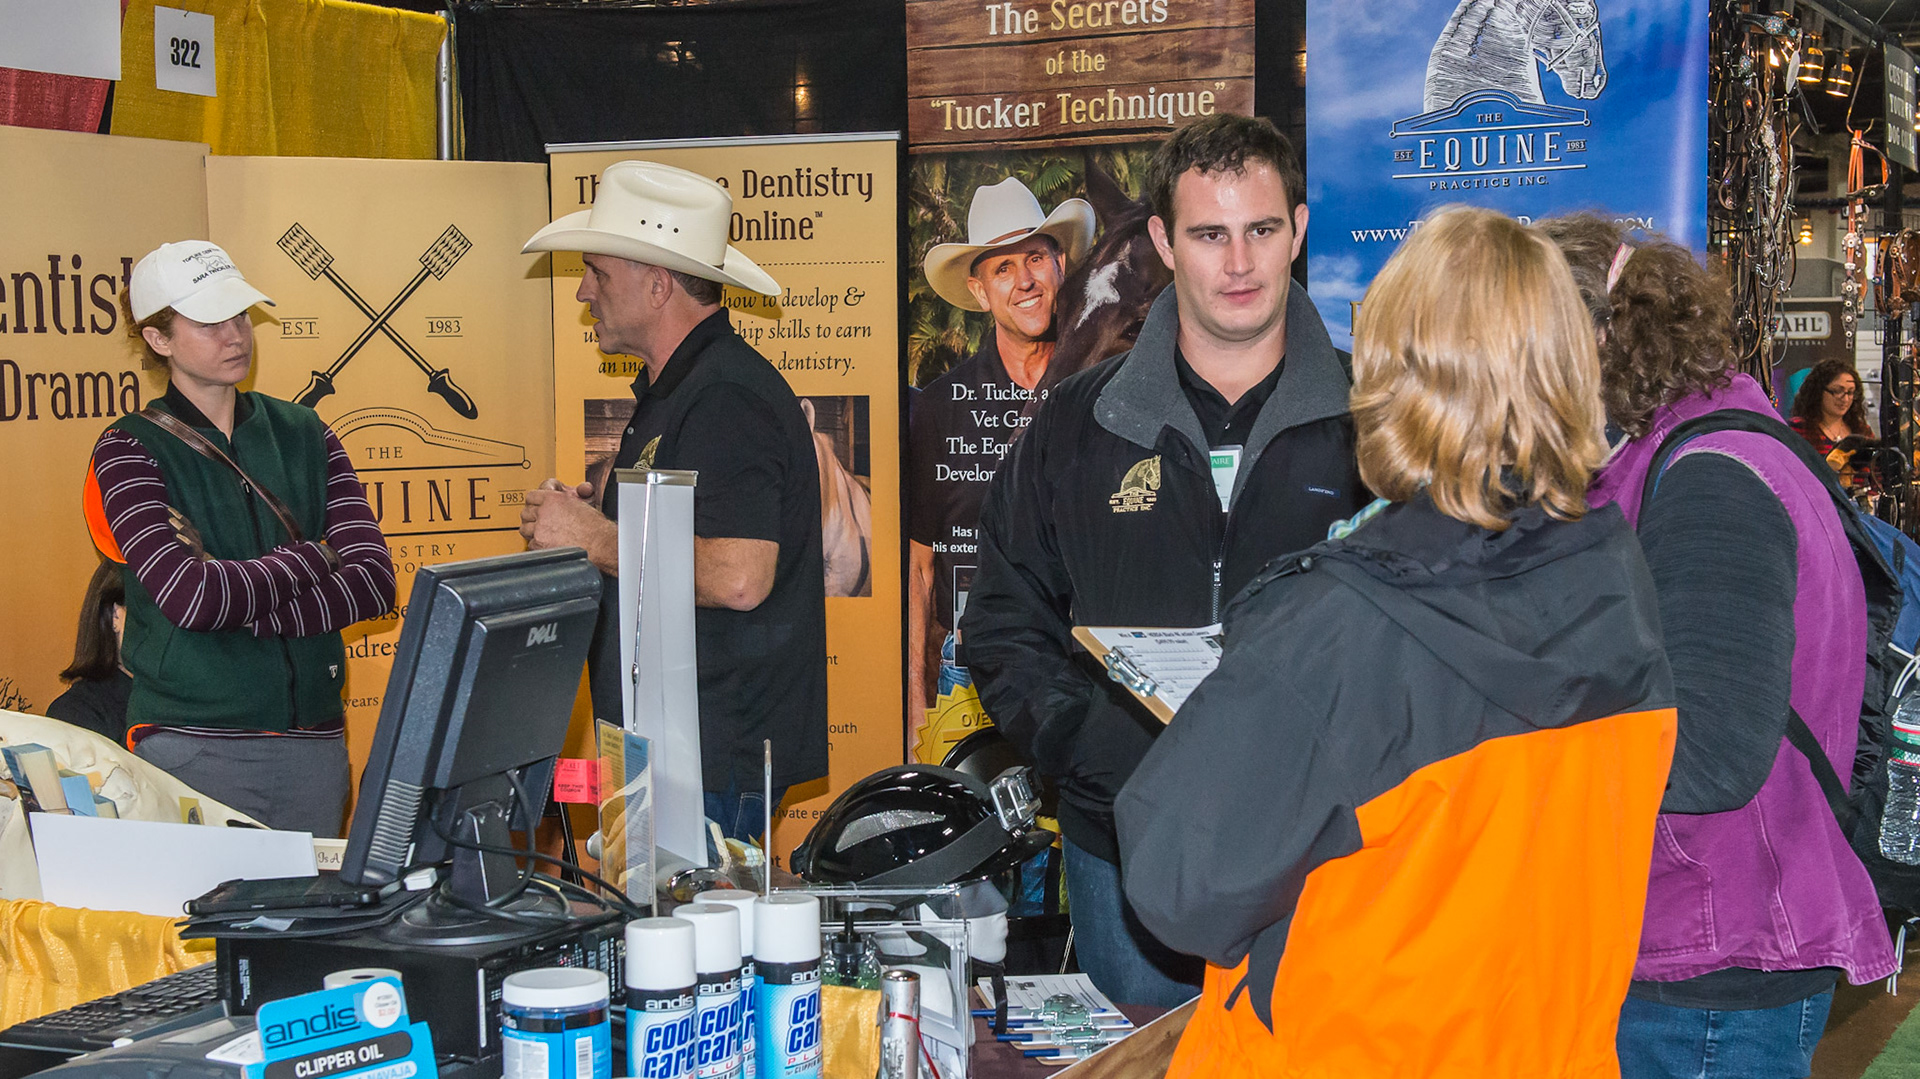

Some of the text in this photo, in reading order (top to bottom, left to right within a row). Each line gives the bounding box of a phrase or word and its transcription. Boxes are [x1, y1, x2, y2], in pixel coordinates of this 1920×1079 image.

[985, 0, 1168, 36] The Secrets
[169, 38, 201, 69] 322
[1045, 50, 1105, 76] of the
[1476, 112, 1503, 124] THE
[1419, 131, 1562, 171] EQUINE
[1566, 139, 1586, 150] 1983
[575, 175, 600, 205] Th
[742, 167, 874, 203] Dentistry
[1429, 175, 1549, 190] PRACTICE INC.
[781, 286, 840, 313] develop
[843, 286, 867, 307] &
[281, 319, 463, 337] EST. 1983
[768, 319, 811, 340] skills
[816, 323, 832, 339] to
[836, 325, 873, 339] earn
[598, 361, 618, 374] an
[777, 350, 856, 377] dentistry.
[951, 383, 978, 401] Dr.
[981, 381, 1038, 403] Tucker,
[970, 410, 999, 428] Vet
[365, 446, 404, 460] THE
[946, 435, 978, 455] The
[499, 492, 525, 504] 1983
[952, 525, 973, 538] Has
[932, 541, 948, 553] his
[526, 622, 558, 648] DELL
[645, 993, 694, 1009] andis
[264, 1004, 357, 1045] andis
[294, 1043, 385, 1078] CLIPPER OIL
